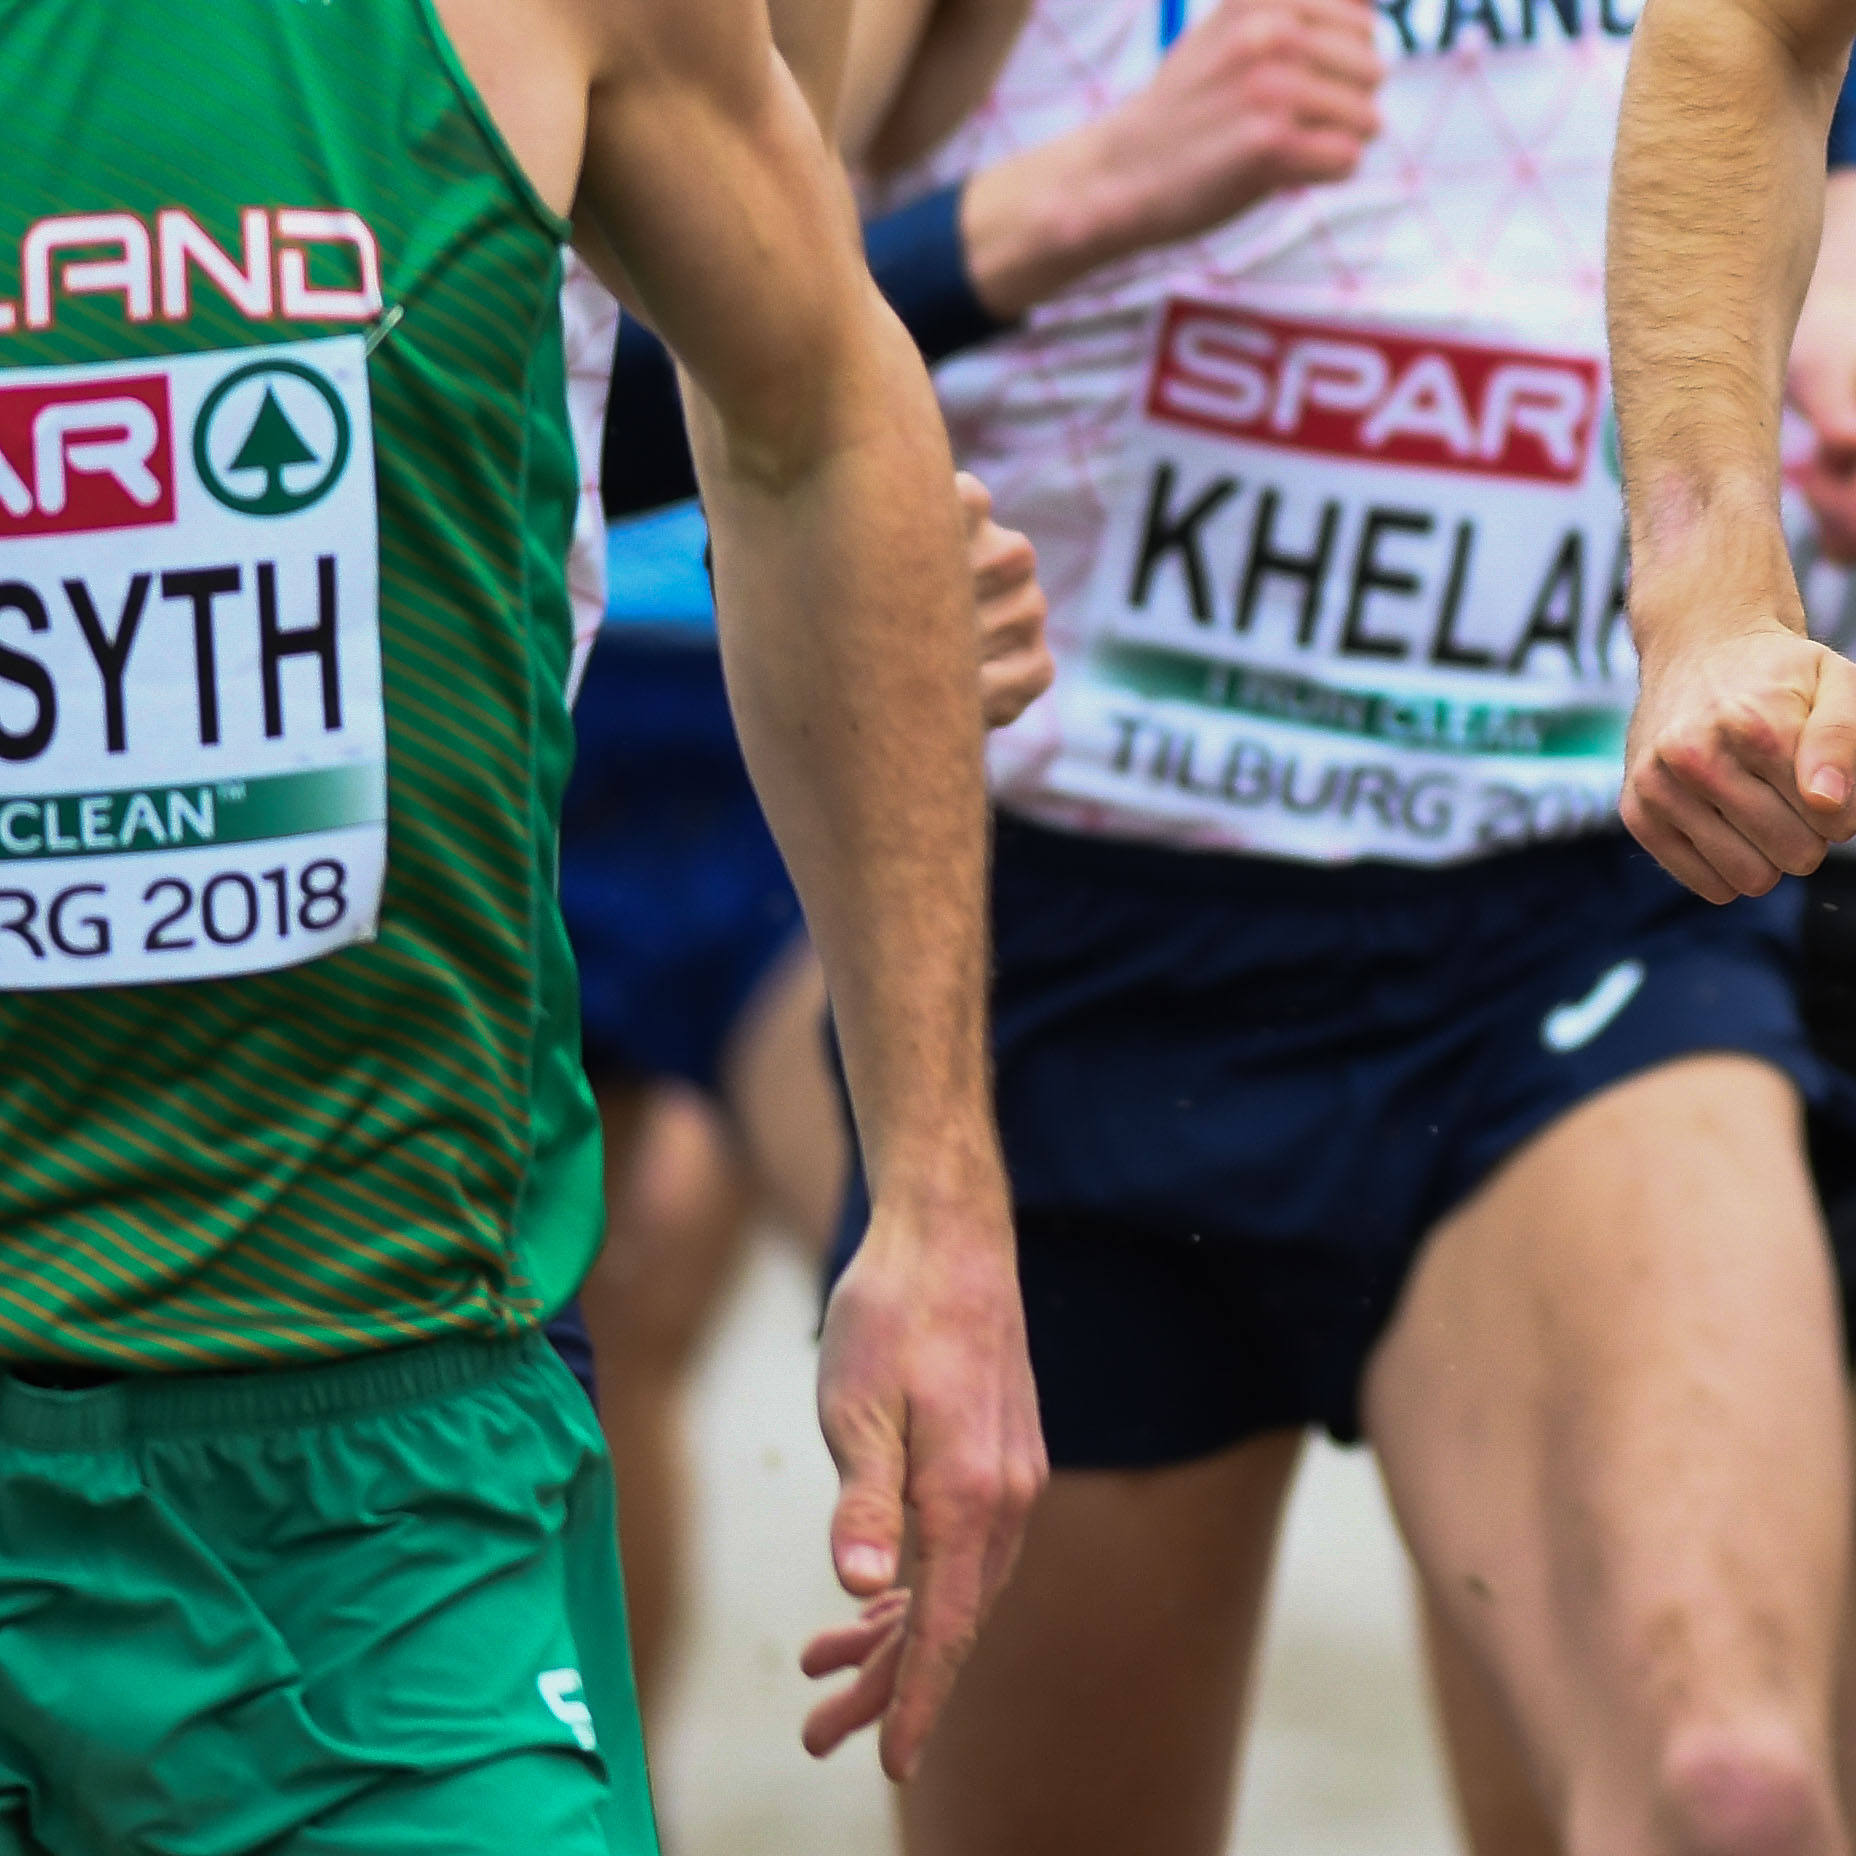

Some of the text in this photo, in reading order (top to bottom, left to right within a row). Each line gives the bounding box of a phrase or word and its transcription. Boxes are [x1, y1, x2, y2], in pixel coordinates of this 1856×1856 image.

[0, 206, 382, 328] AND
[1163, 317, 1588, 470] SPAR
[1107, 713, 1454, 843] TILBURG
[142, 858, 347, 953] 2018
